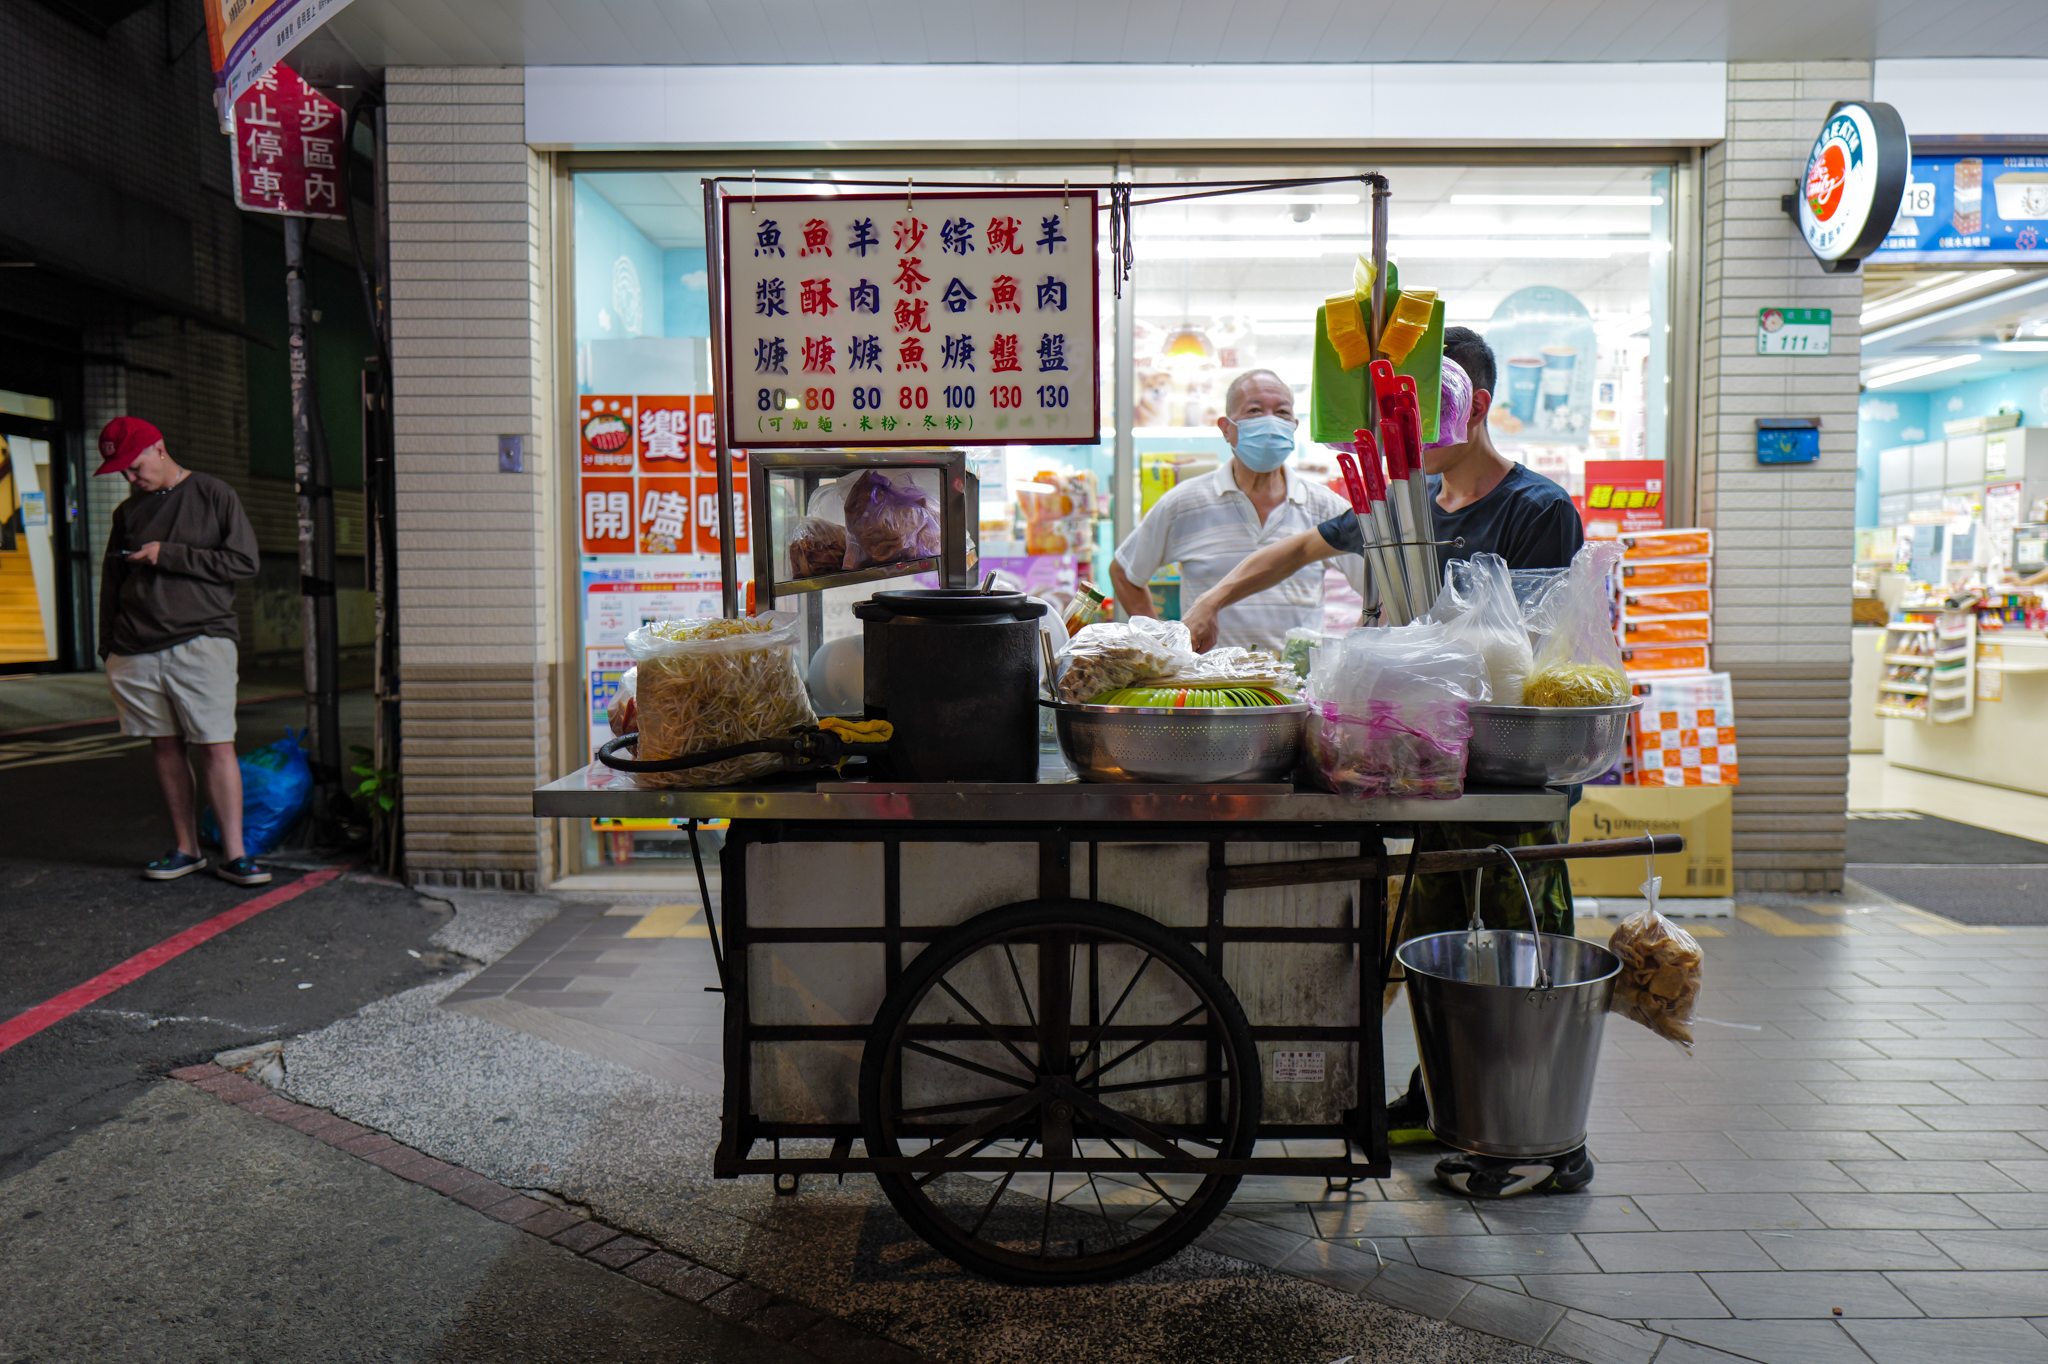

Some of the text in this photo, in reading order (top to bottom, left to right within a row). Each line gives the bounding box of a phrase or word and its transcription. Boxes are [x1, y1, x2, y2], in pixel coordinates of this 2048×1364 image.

[893, 217, 931, 373] 沙茶魷魚
[986, 216, 1024, 373] 魷魚盤
[1036, 215, 1069, 373] 羊肉盤
[757, 388, 787, 411] 80
[805, 387, 835, 411] 80
[852, 386, 881, 410] 80
[899, 386, 928, 410] 80
[943, 385, 975, 409] 100
[989, 385, 1022, 409] 130
[1036, 385, 1069, 408] 130
[1614, 819, 1681, 831] UNIDESIGN
